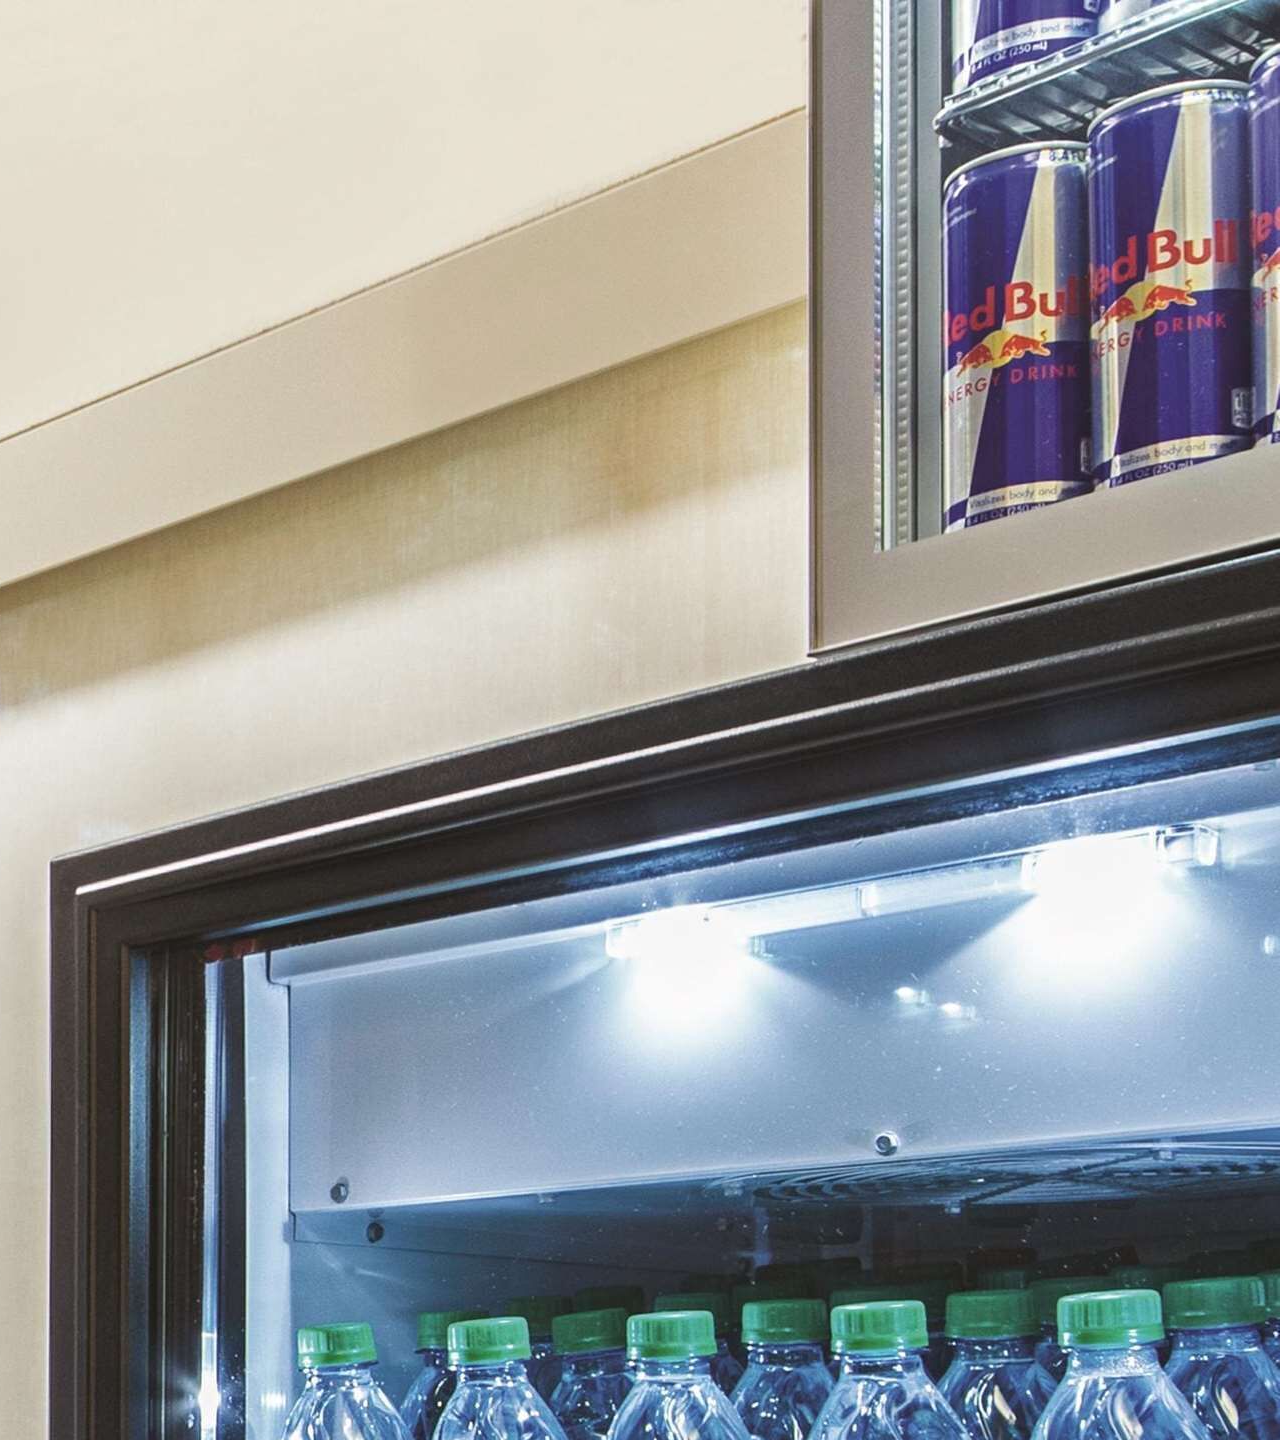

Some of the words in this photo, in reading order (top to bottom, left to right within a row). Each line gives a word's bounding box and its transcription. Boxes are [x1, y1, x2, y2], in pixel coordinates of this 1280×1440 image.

[1147, 218, 1237, 273] Bull
[1091, 327, 1143, 362] NERGY
[1154, 311, 1228, 337] DRINK
[947, 376, 1000, 406] NERGY
[1010, 365, 1080, 384] DRINK
[1154, 444, 1182, 459] body
[1185, 439, 1205, 452] and
[1009, 485, 1036, 500] body
[1038, 484, 1058, 498] and
